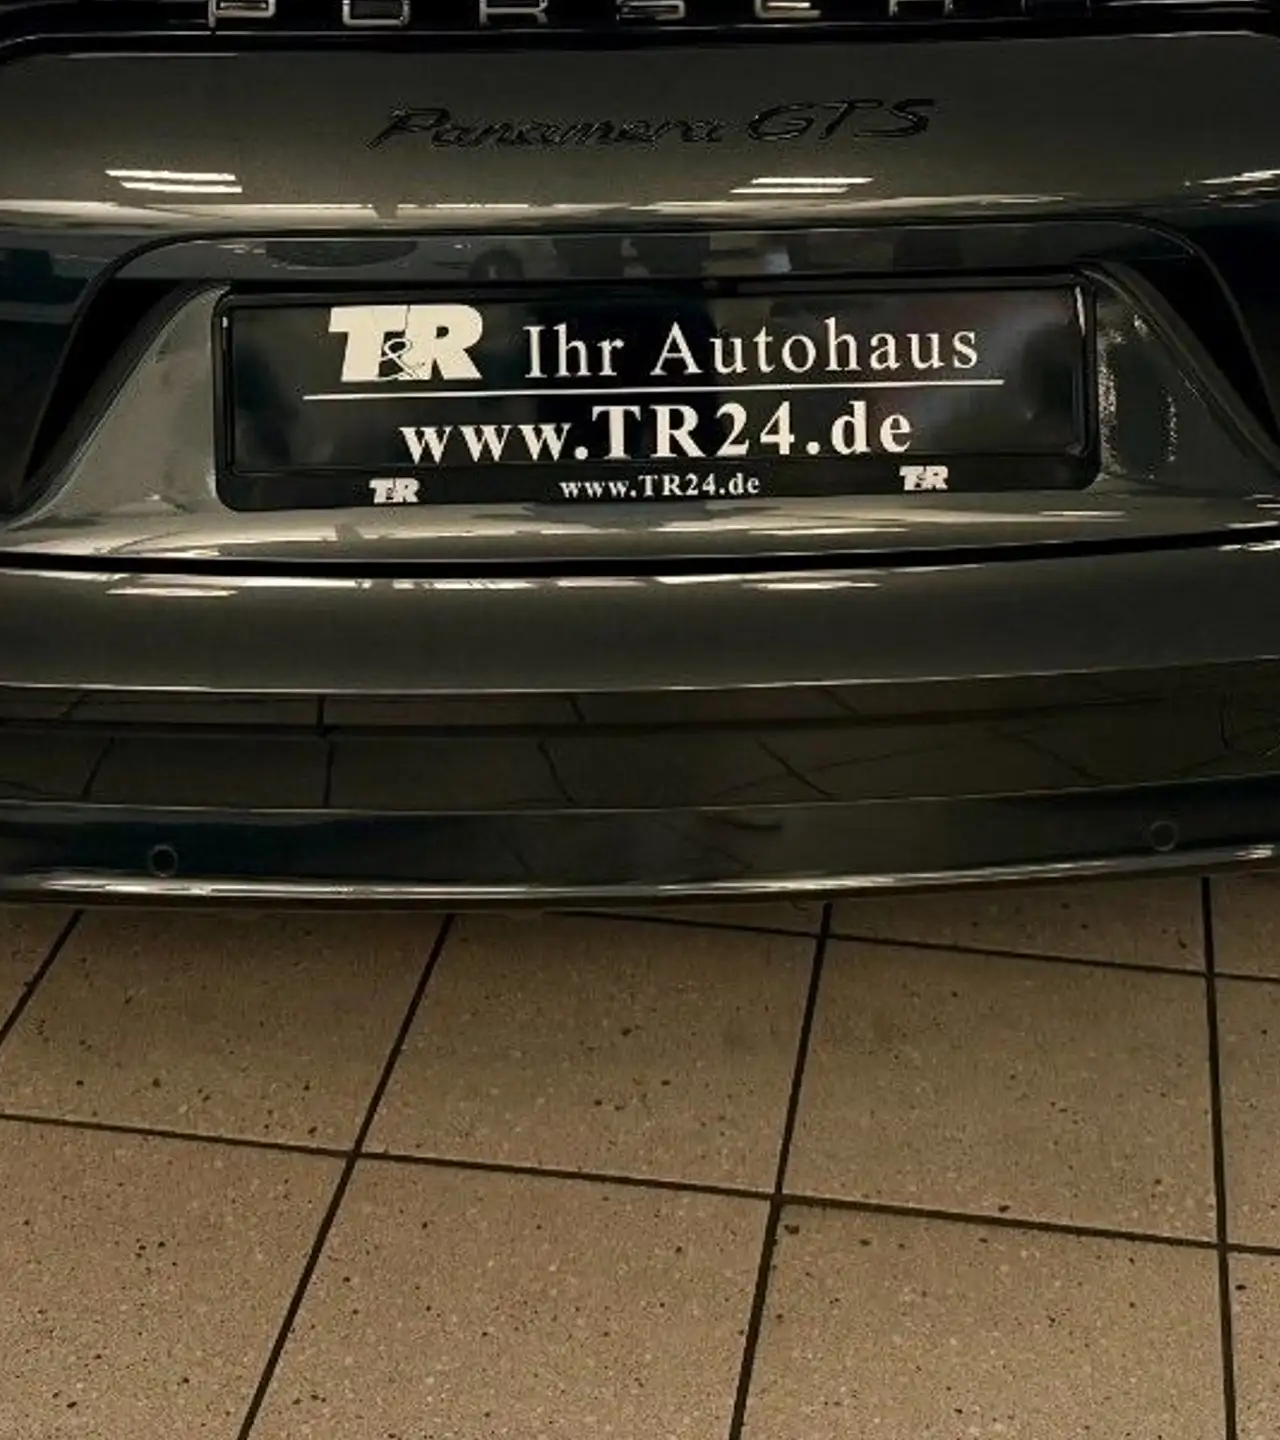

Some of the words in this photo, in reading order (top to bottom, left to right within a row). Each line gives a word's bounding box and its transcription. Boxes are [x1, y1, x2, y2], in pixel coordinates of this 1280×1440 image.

[366, 104, 721, 150] Panamera
[746, 98, 936, 141] GTS
[523, 322, 625, 379] Ihr
[649, 316, 980, 376] Autohaus
[399, 400, 913, 464] www.TR24.de
[559, 472, 761, 498] www.TR24.de
